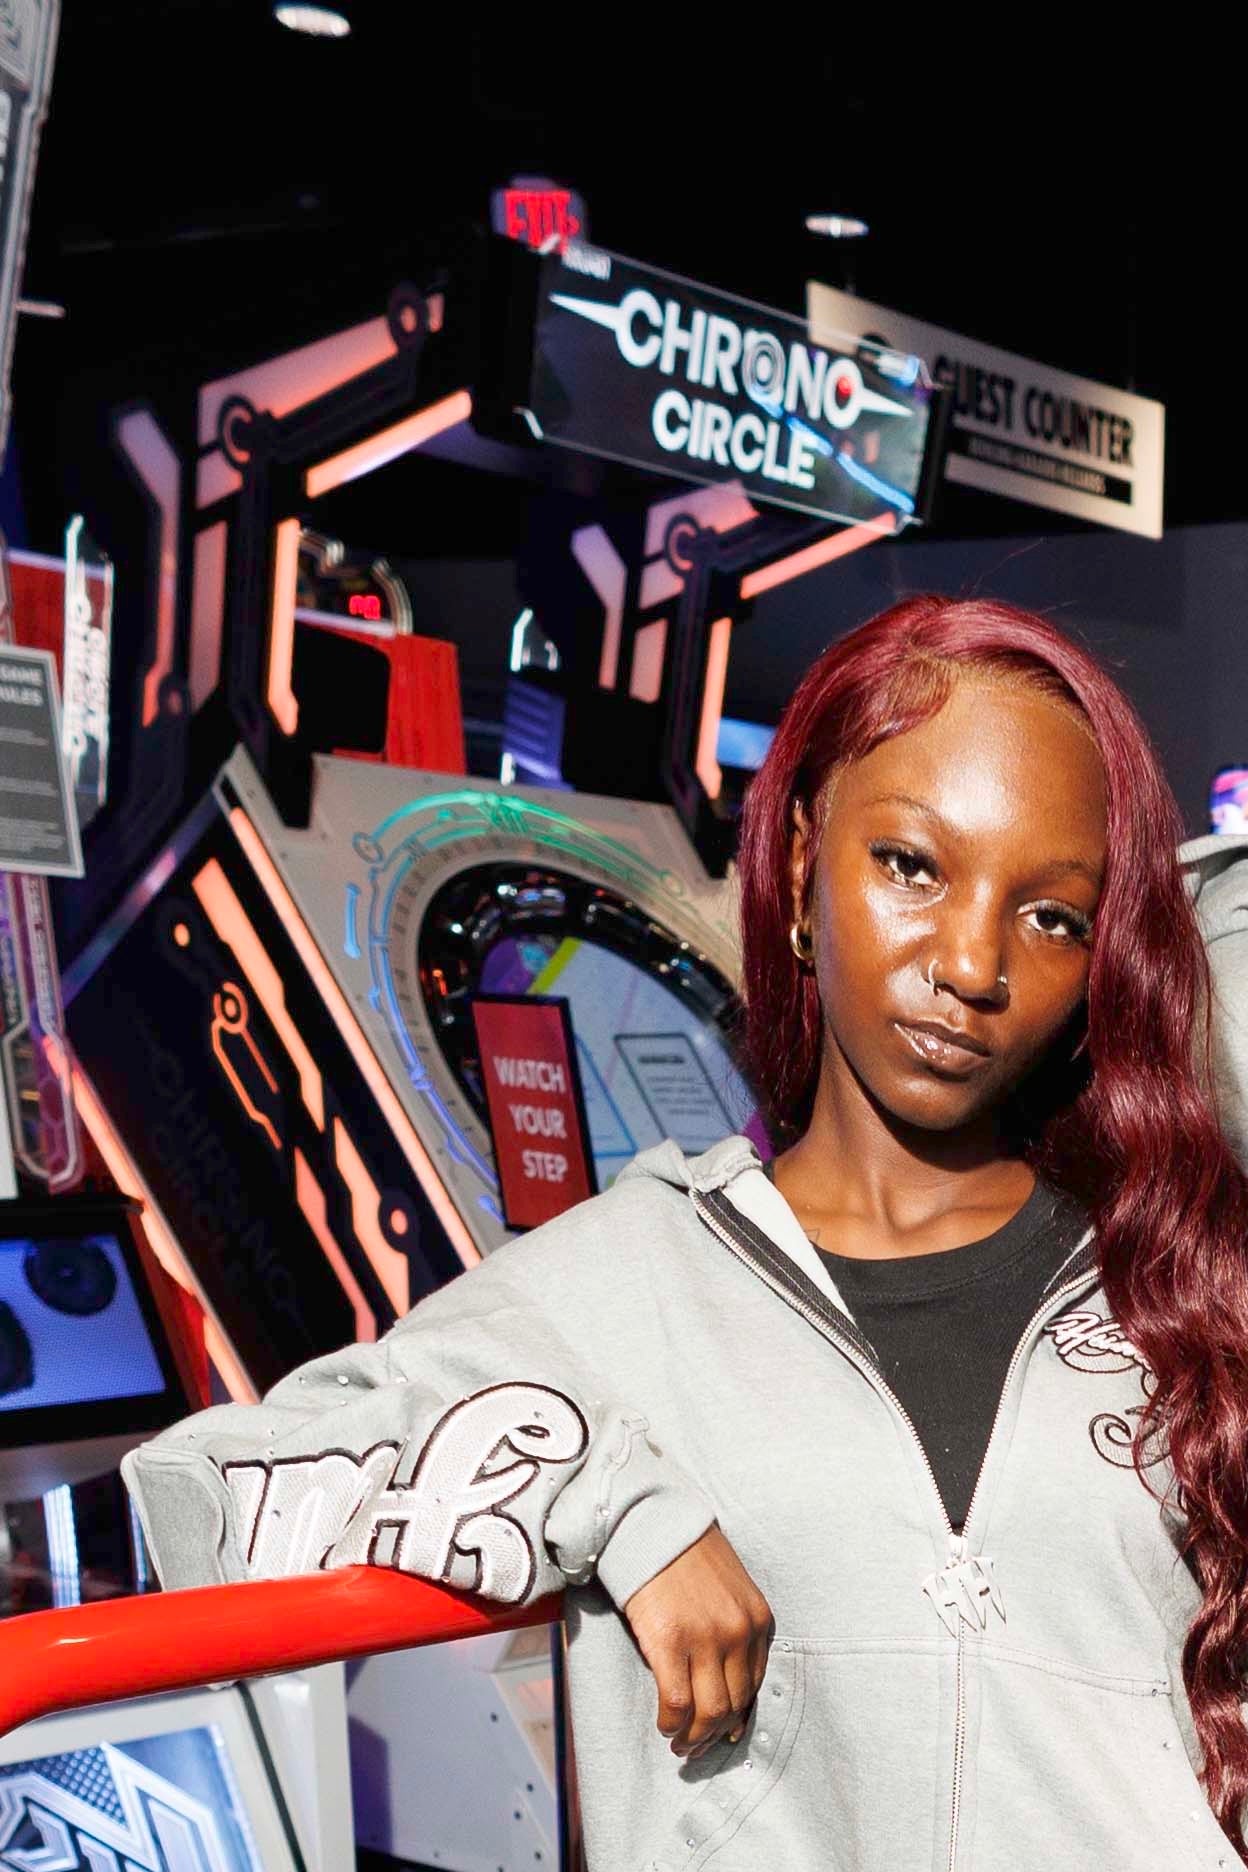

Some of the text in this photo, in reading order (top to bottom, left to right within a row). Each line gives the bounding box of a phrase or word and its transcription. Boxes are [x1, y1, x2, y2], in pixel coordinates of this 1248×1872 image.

[549, 288, 912, 429] CHRONO
[651, 389, 817, 491] CIRCLE
[1023, 386, 1135, 468] COUNTER
[493, 1056, 566, 1093] WATCH
[510, 1105, 567, 1139] YOUR
[522, 1151, 569, 1183] STEP
